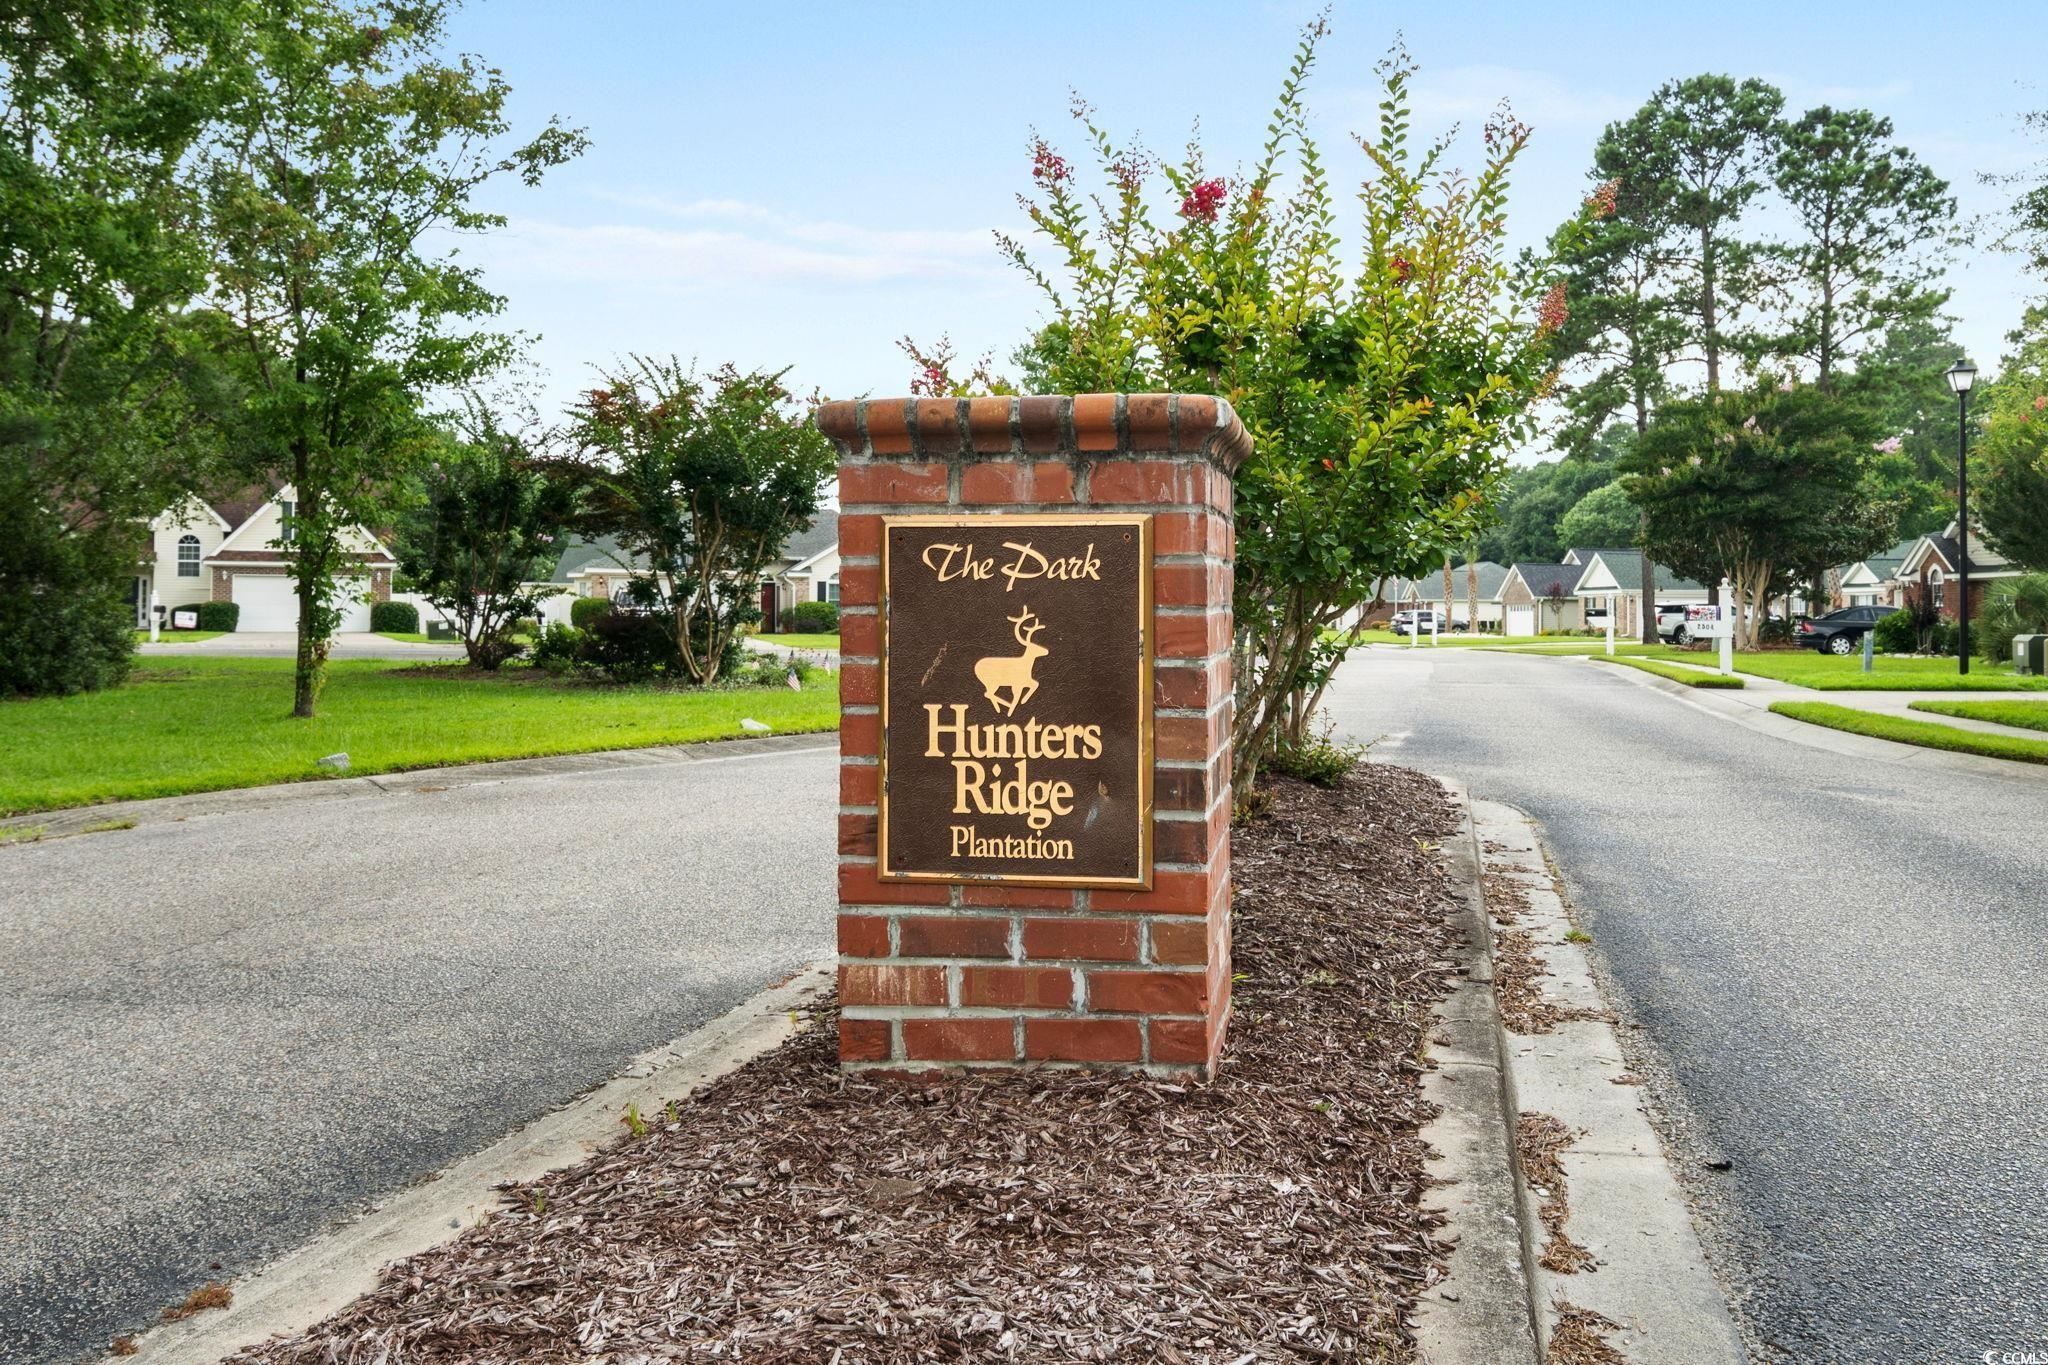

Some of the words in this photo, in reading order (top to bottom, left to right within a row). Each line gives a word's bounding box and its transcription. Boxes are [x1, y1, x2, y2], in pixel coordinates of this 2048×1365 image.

[922, 543, 994, 582] The
[1000, 541, 1101, 593] Park
[922, 703, 1103, 760] Hunters
[951, 757, 1075, 830] Ridge
[949, 826, 1075, 860] Plantation
